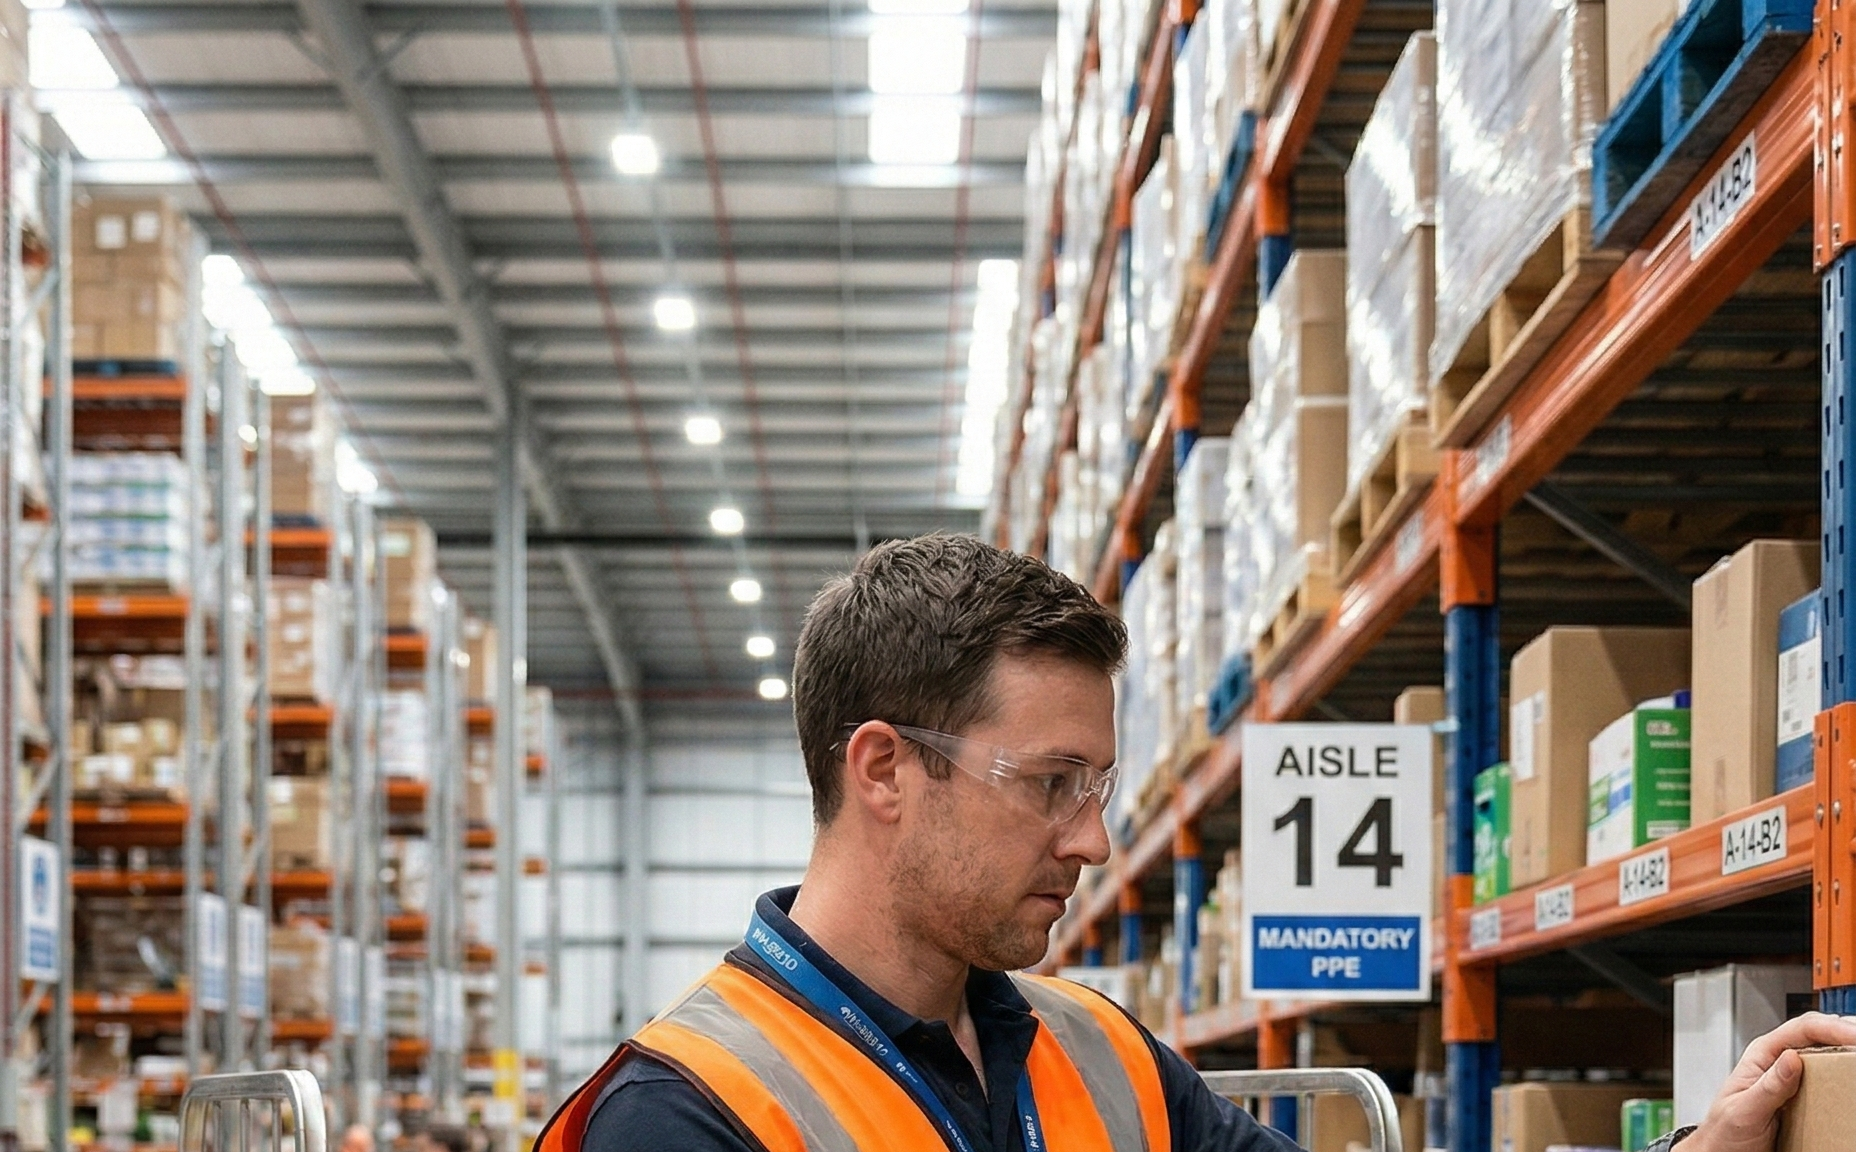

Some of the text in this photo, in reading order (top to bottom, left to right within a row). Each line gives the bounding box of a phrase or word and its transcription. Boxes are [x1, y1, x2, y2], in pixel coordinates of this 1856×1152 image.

[1275, 745, 1399, 778] AISLE
[1273, 797, 1404, 887] 14
[1724, 815, 1782, 866] A-14-B2
[1258, 927, 1415, 949] MANDATORY
[1311, 956, 1362, 978] PPE
